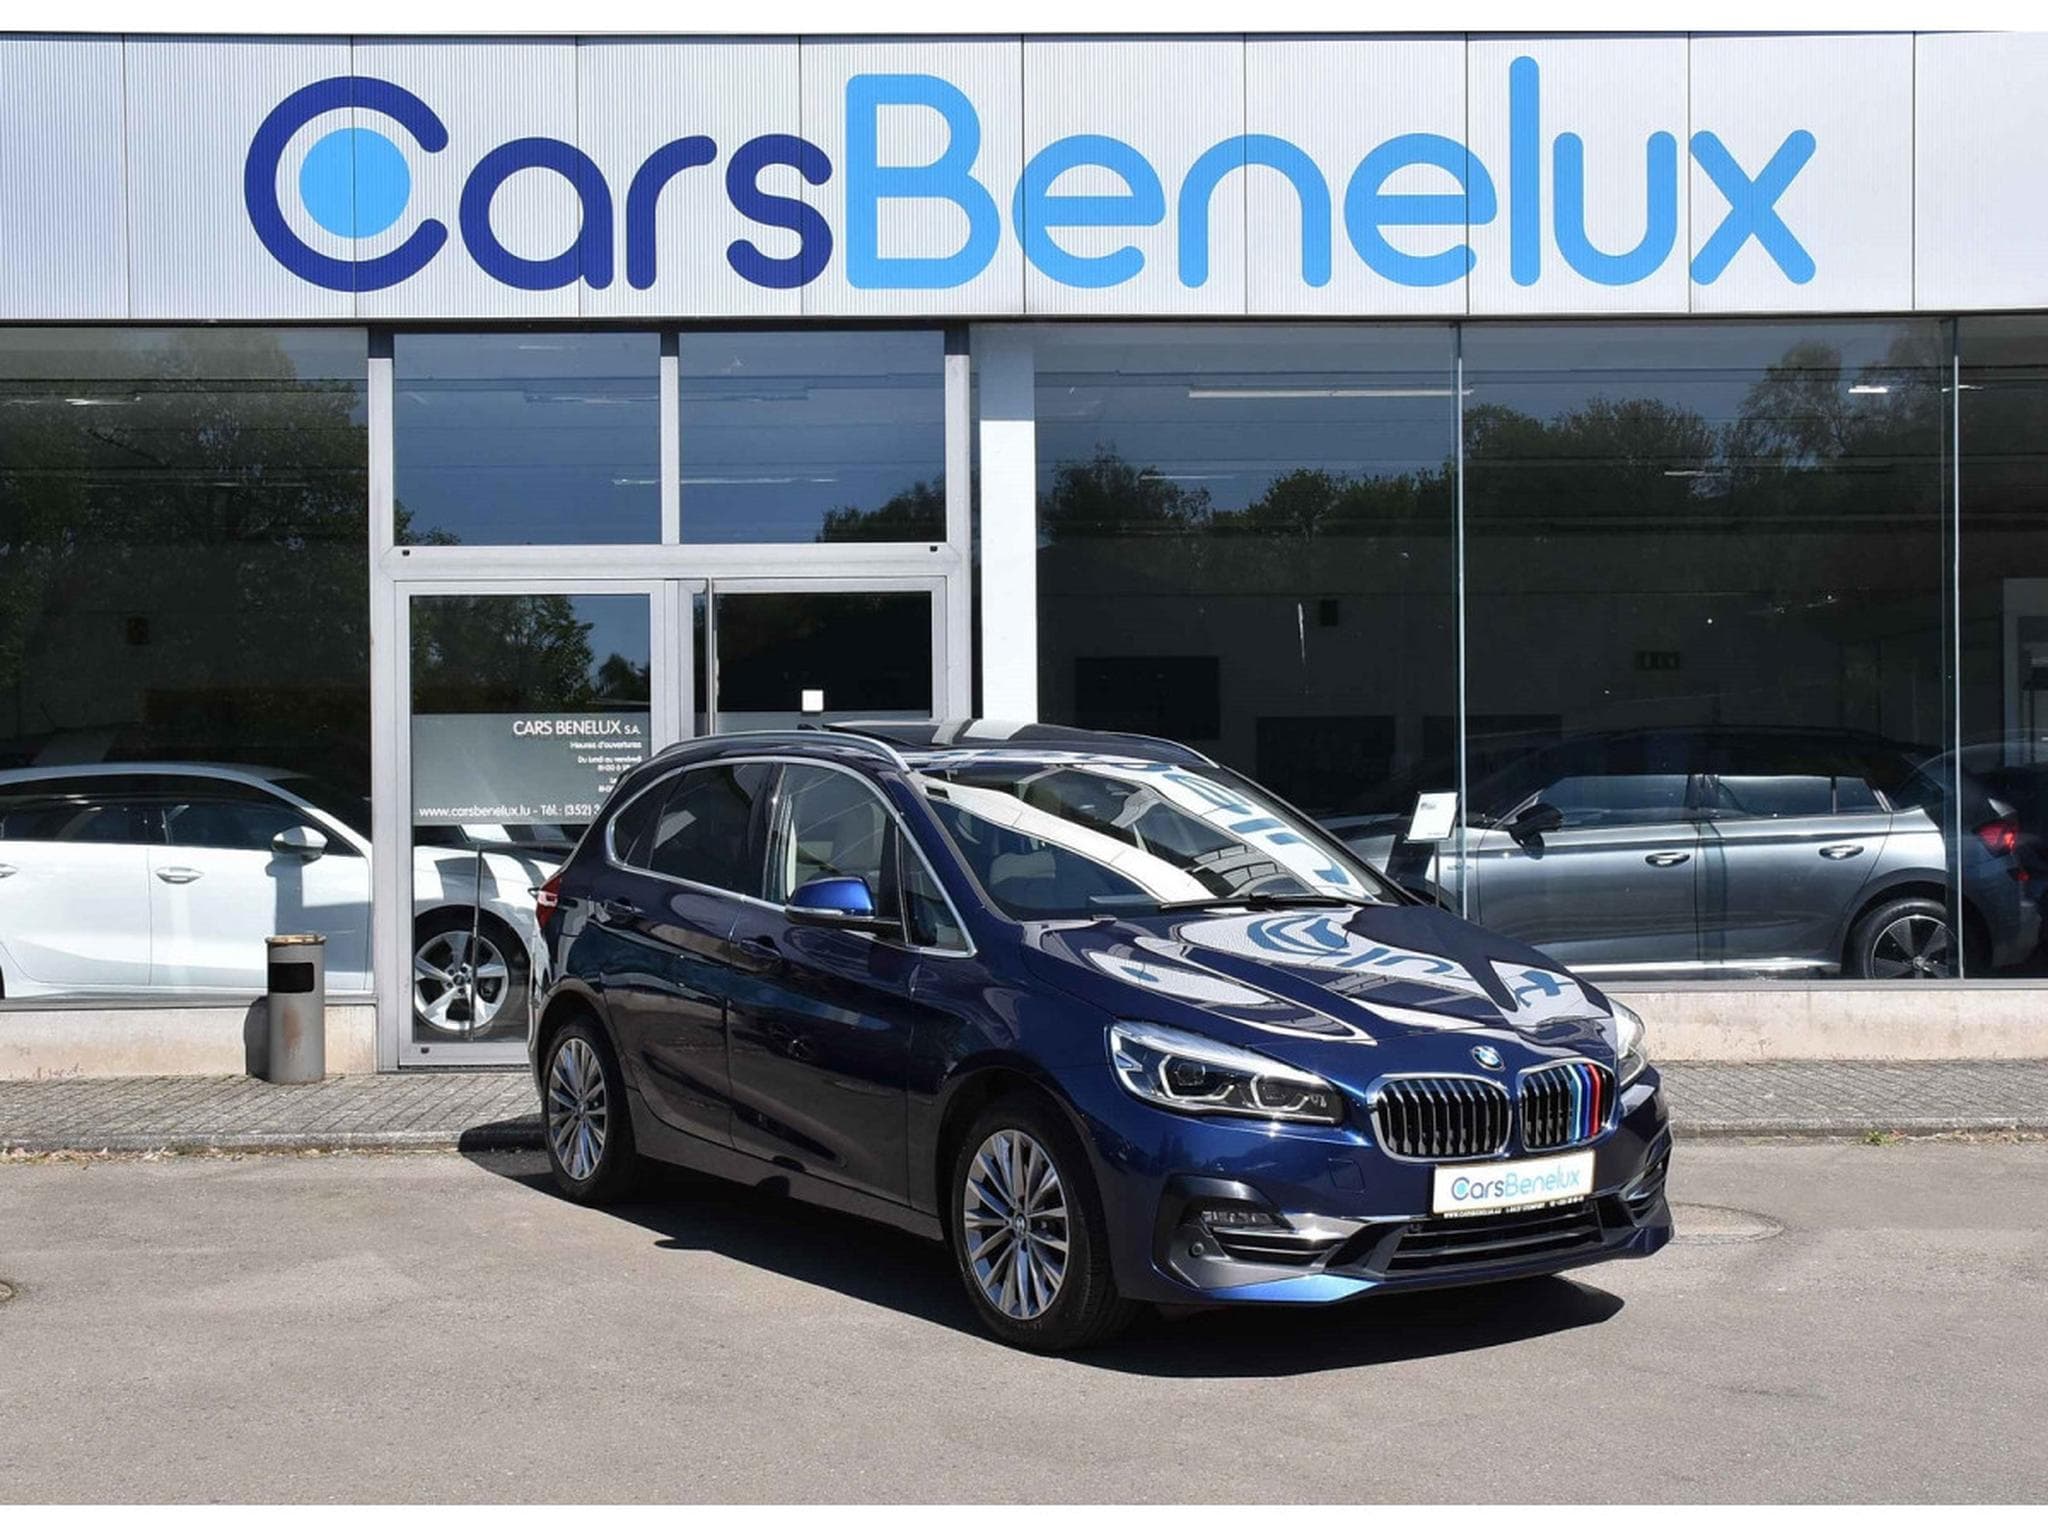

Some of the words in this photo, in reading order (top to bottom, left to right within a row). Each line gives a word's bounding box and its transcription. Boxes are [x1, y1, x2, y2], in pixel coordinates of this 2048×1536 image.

[244, 56, 1816, 292] CarsBenelux
[513, 720, 552, 735] CARS
[555, 720, 621, 735] BENELUX
[419, 805, 530, 817] www.carsbenelux.lu
[565, 803, 592, 817] (352)
[1451, 1165, 1580, 1201] CarsBenelux
